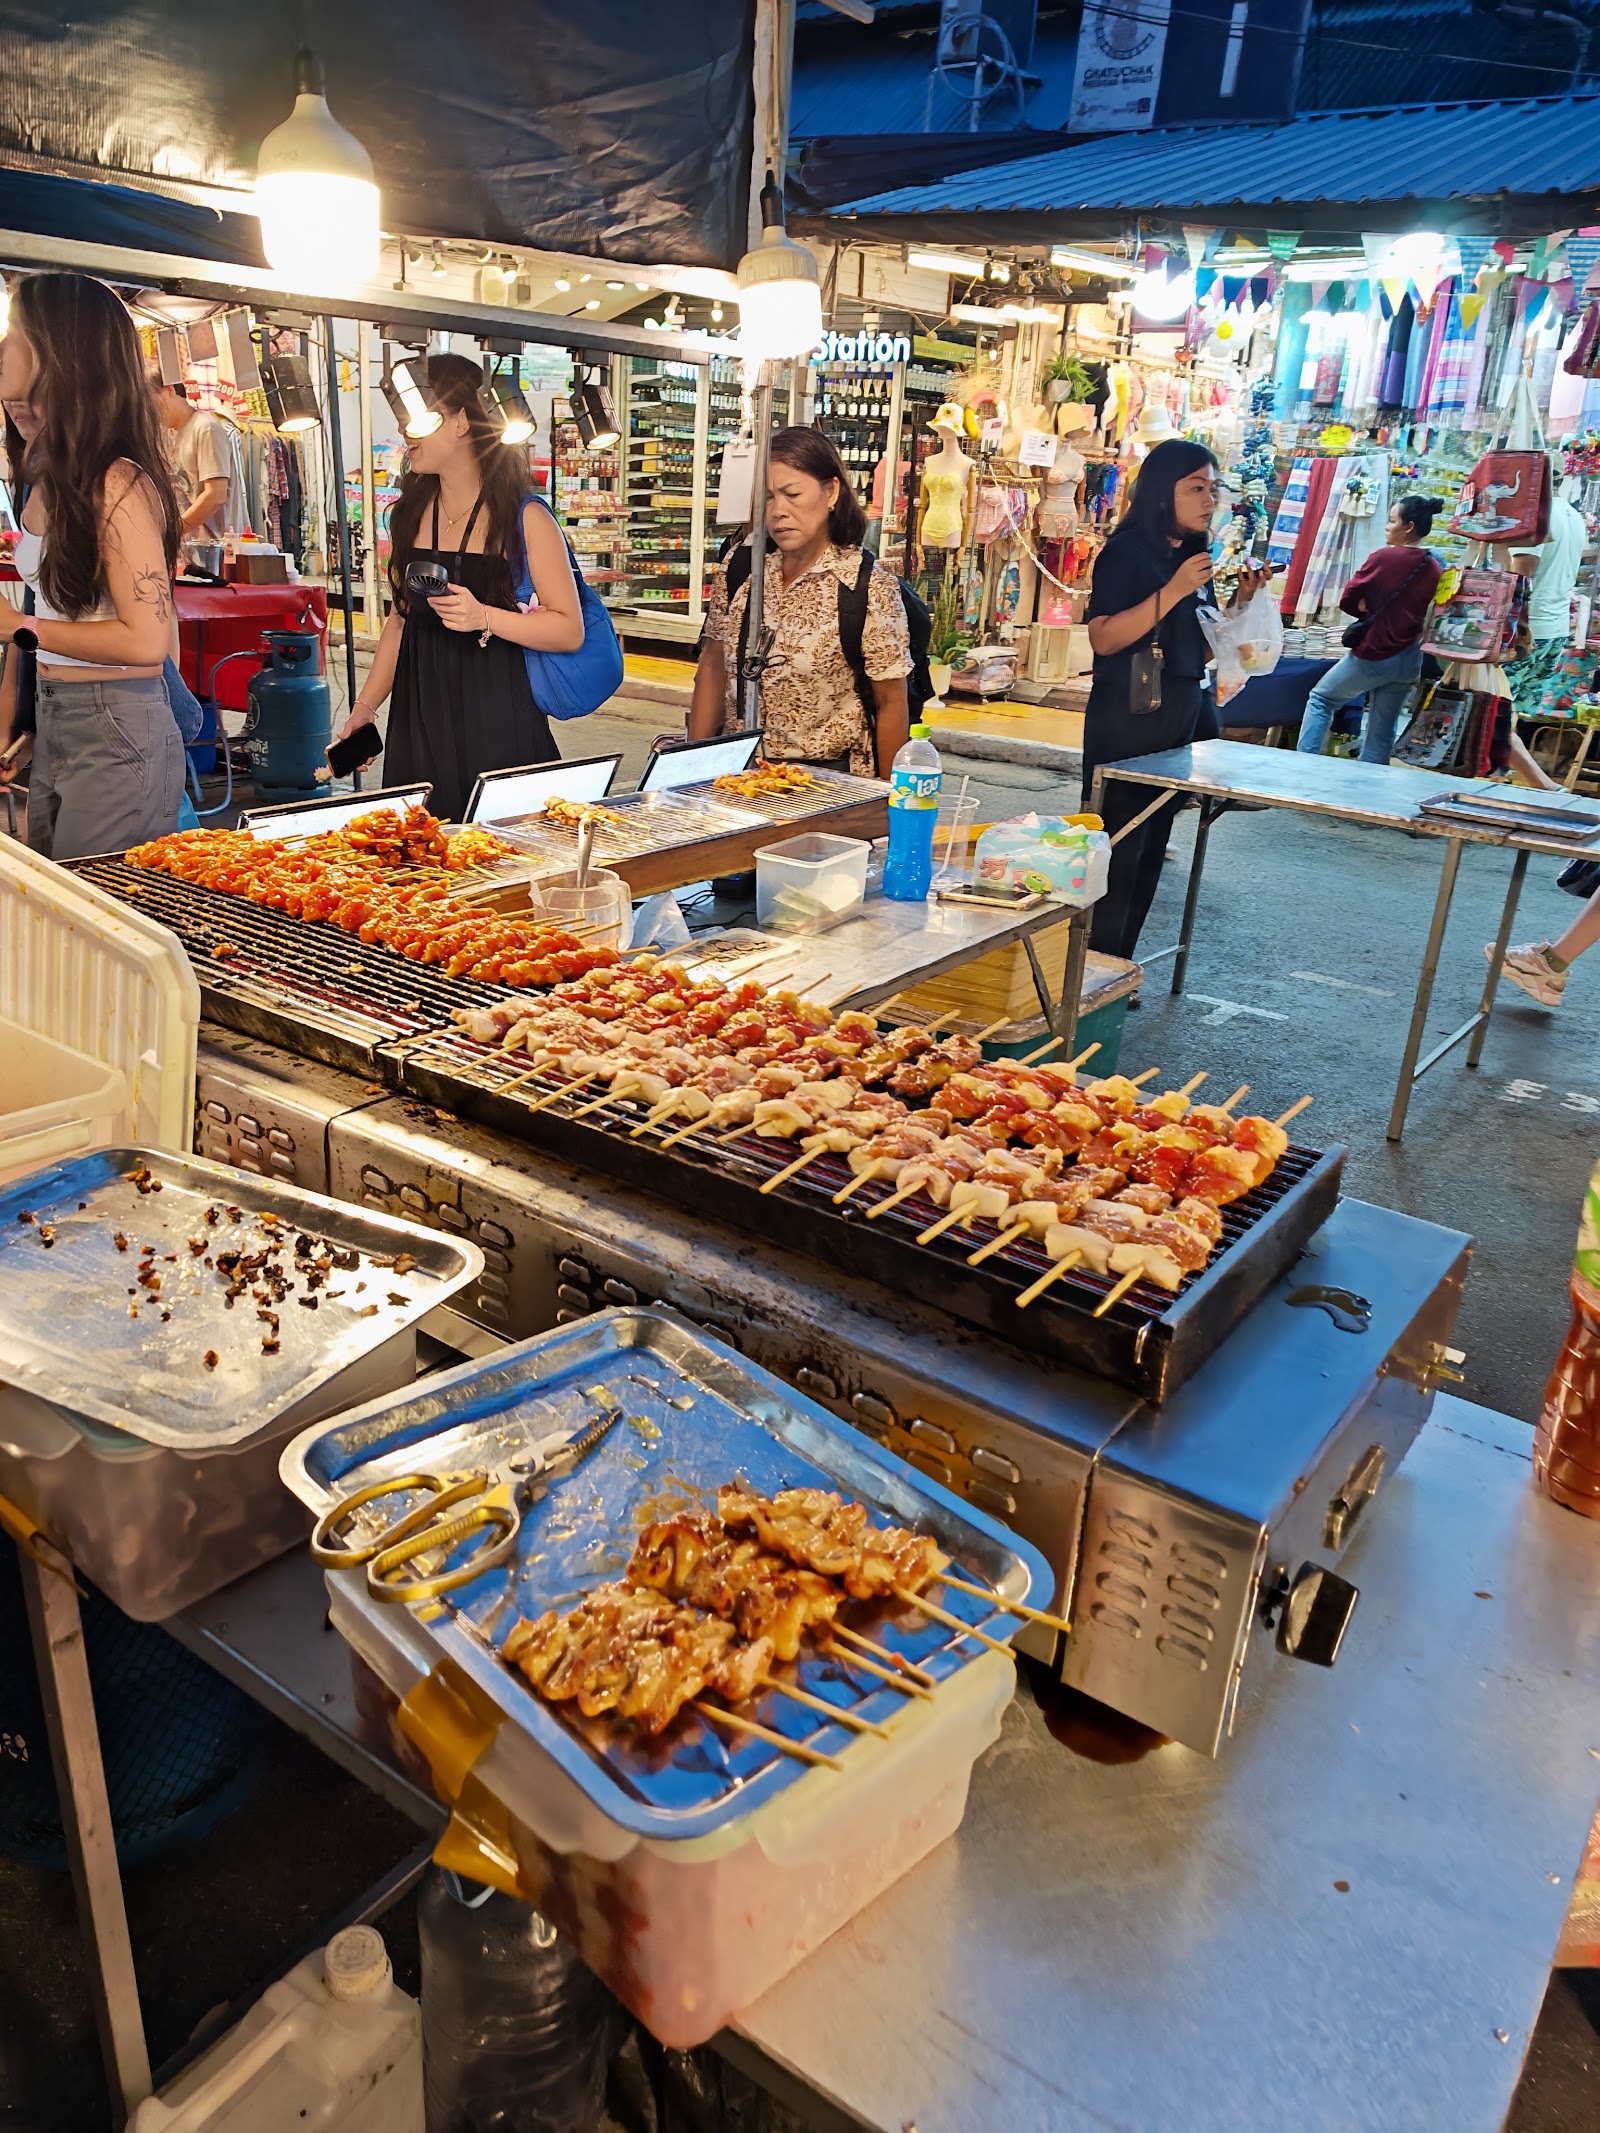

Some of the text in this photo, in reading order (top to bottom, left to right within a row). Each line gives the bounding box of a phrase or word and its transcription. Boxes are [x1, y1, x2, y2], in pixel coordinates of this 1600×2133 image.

[812, 330, 911, 361] Station
[215, 382, 234, 396] 200
[344, 488, 362, 500] Tha
